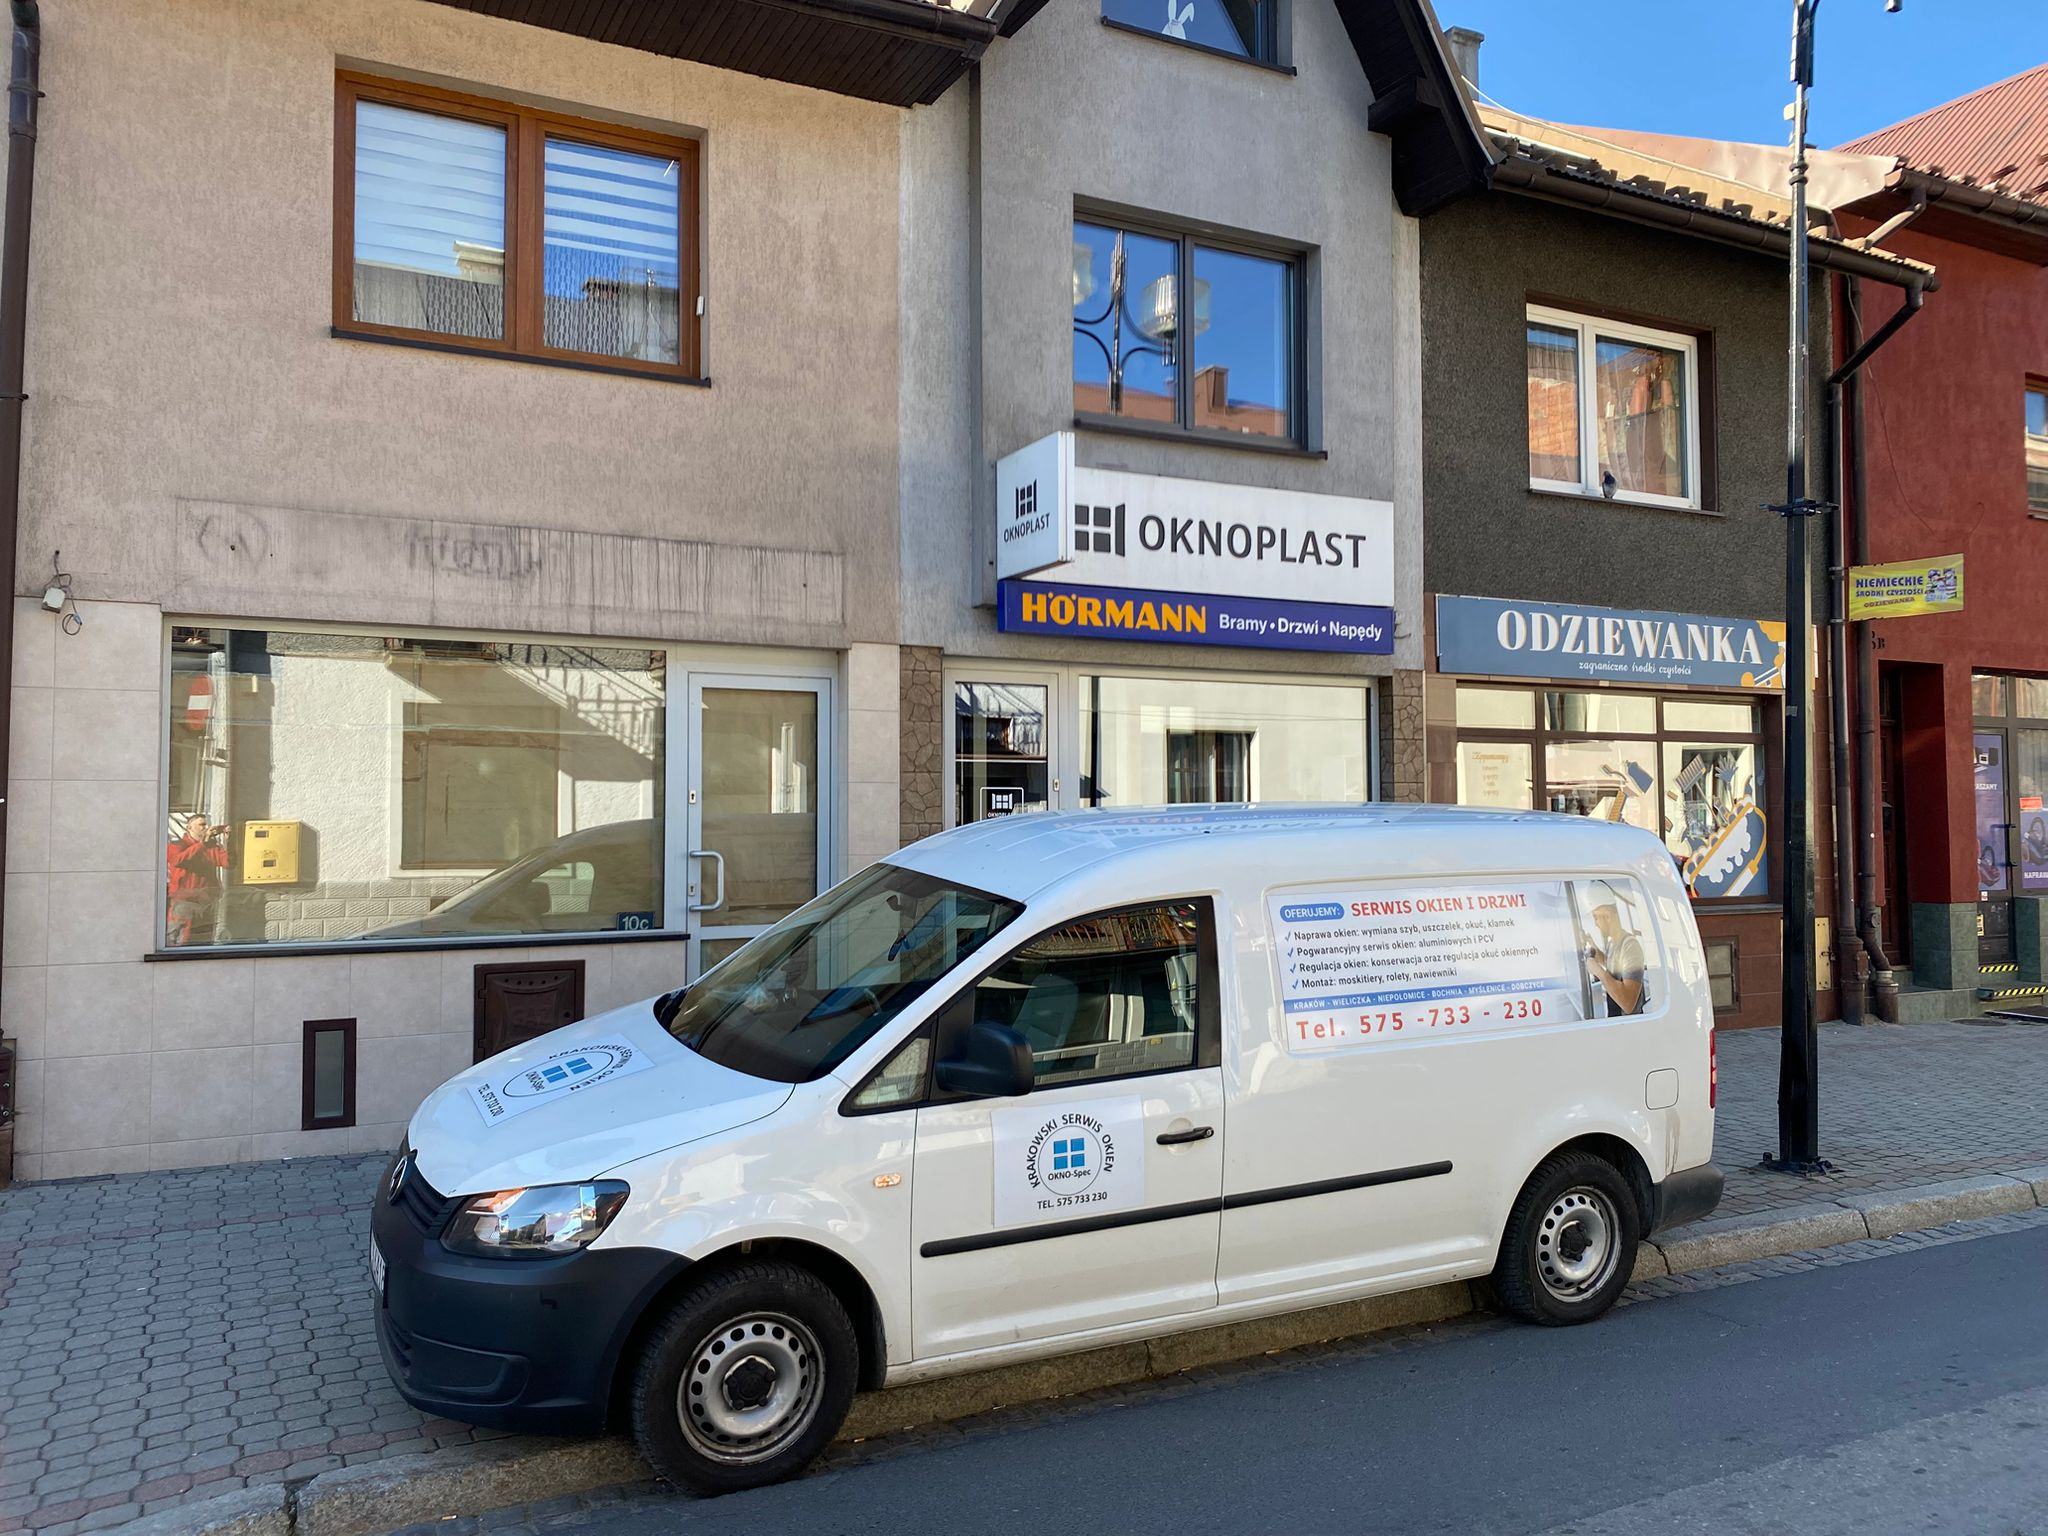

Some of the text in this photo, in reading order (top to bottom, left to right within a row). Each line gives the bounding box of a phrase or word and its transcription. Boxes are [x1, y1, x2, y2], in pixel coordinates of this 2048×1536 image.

[1004, 512, 1050, 543] OKNOPLAST
[1138, 515, 1366, 568] OKNOPLAST
[1856, 576, 1923, 588] NIEMIECKIE
[1863, 597, 1915, 608] ODZIEWANKA
[1022, 591, 1383, 641] HÖRMANN Bramy Drzwi Napędy
[1496, 609, 1764, 665] ODZIEWANKA
[1579, 661, 1692, 679] zagraniczne środki czystości
[1284, 894, 1527, 919] OFERUJEMY: SERWIS OKIEN I DRZWI
[622, 915, 649, 930] 10c
[1294, 918, 1515, 941] Naprawa okien: wymiana szyb, uszczelek, okuć, klamek
[1297, 943, 1360, 957] Pogwarancyjny
[1363, 942, 1390, 952] serwis
[1392, 940, 1416, 950] okien:
[1419, 936, 1472, 948] aluminiowych
[1478, 934, 1495, 944] PCV
[1300, 946, 1539, 973] Regulacja okien: konserwacja oraz regulacja okuć okiennych
[1302, 967, 1458, 989] Montaż: moskitiery, rolety, nawiewniki
[1293, 981, 1545, 1010] KRAKÓW WIELICZKA NIEPOŁOMICE BOCHNIA MYŚLENICE DOBCZYCE
[1296, 1017, 1345, 1040] Tel.
[1360, 1012, 1403, 1034] 575
[1503, 999, 1542, 1019] 230
[1026, 1113, 1114, 1189] KRAKOWSKI SERWIS OKIEN
[1048, 1169, 1091, 1181] OKNO-Spec
[1037, 1191, 1108, 1210] TEL. 575 733 230
